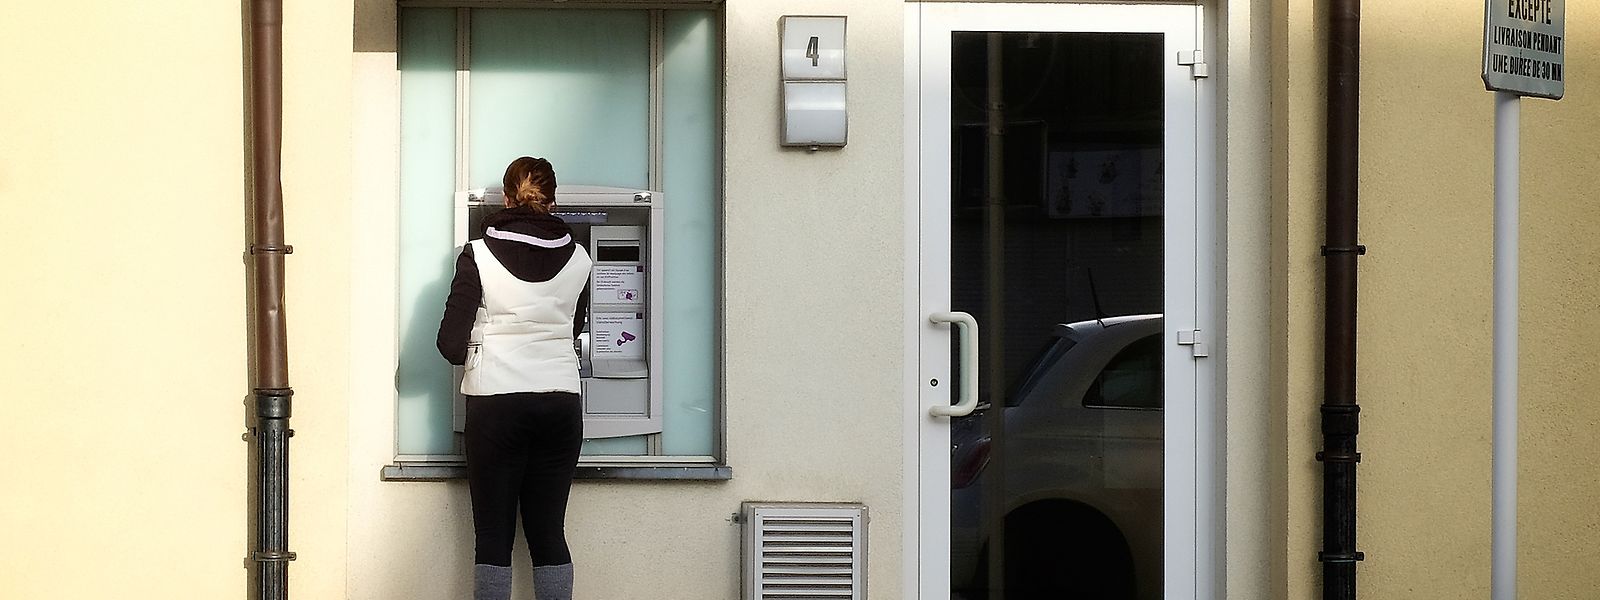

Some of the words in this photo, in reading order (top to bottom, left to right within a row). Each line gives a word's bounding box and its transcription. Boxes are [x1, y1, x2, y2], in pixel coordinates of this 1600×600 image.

[806, 36, 820, 67] 4
[1494, 26, 1532, 50] LIVRAISON
[1533, 31, 1562, 54] PENDANT
[1492, 54, 1508, 73] UNE
[1532, 59, 1541, 79] DE
[1541, 61, 1551, 80] 30
